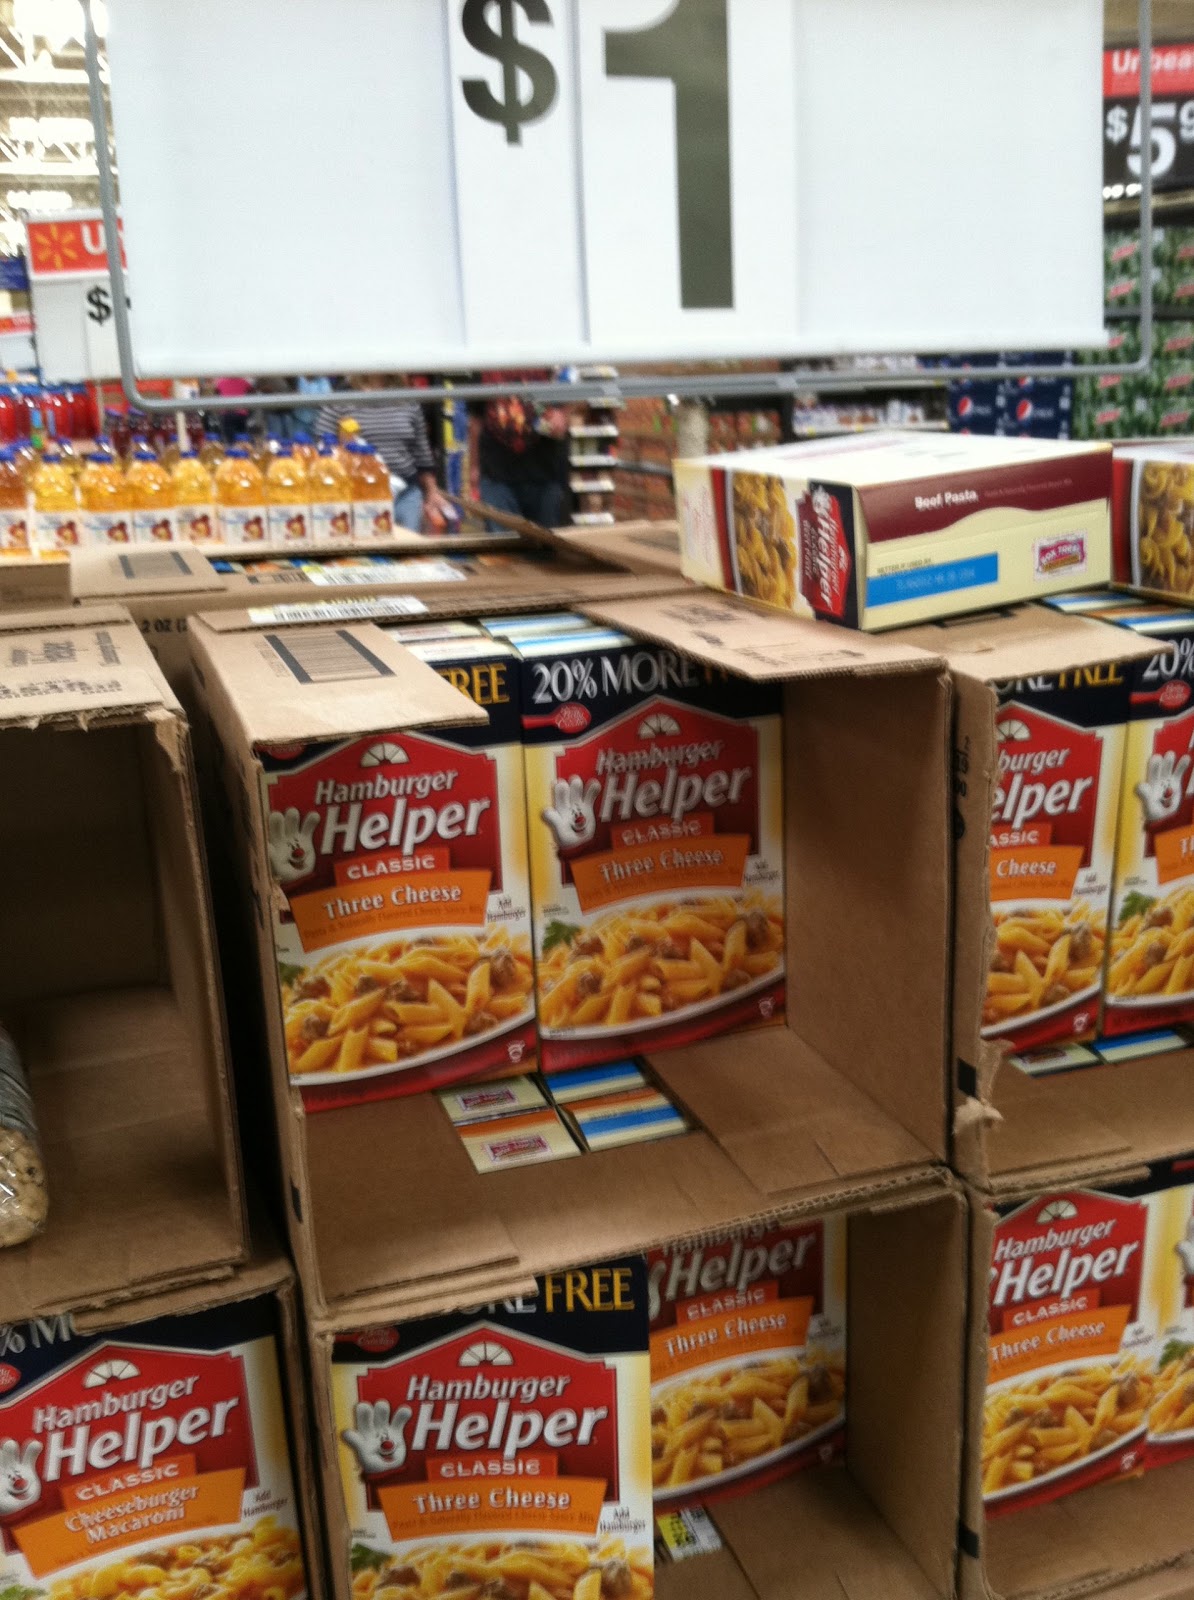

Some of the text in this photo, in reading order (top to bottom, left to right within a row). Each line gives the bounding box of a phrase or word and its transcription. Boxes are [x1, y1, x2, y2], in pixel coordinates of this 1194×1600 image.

[914, 489, 979, 510] Beef Pasta
[816, 516, 833, 611] Helper
[532, 656, 598, 704] 20%
[602, 651, 698, 695] MORE
[595, 739, 725, 776] Hamburger
[998, 748, 1070, 775] burger
[314, 769, 459, 807] Hamburger
[600, 762, 751, 823] Helper
[320, 796, 491, 857] Helper
[621, 820, 702, 846] CLASSIC
[989, 830, 1039, 848] ASSIC
[346, 855, 435, 880] CLASSIC
[600, 846, 725, 884] Three Cheese
[996, 858, 1057, 878] Cheese
[323, 882, 462, 920] Three Cheese
[994, 1218, 1117, 1262] Hamburger
[666, 1233, 816, 1301] Helper
[993, 1240, 1140, 1306] Helper
[545, 1267, 635, 1313] FREE
[687, 1288, 766, 1321] CLASSIC
[1013, 1296, 1088, 1326] CLASSIC
[665, 1326, 718, 1357] Three
[724, 1311, 787, 1338] Cheese
[990, 1334, 1041, 1362] Three
[1046, 1320, 1106, 1344] Cheese
[33, 1374, 200, 1434] Hamburger
[406, 1372, 570, 1403] Hamburger
[43, 1397, 239, 1482] Helper
[411, 1399, 608, 1461] Helper
[76, 1463, 180, 1501] CLASSIC
[440, 1459, 540, 1478] CLASSIC
[65, 1484, 200, 1532] Cheeseburger
[413, 1485, 570, 1514] Three Cheese
[87, 1505, 185, 1544] Macaroni
